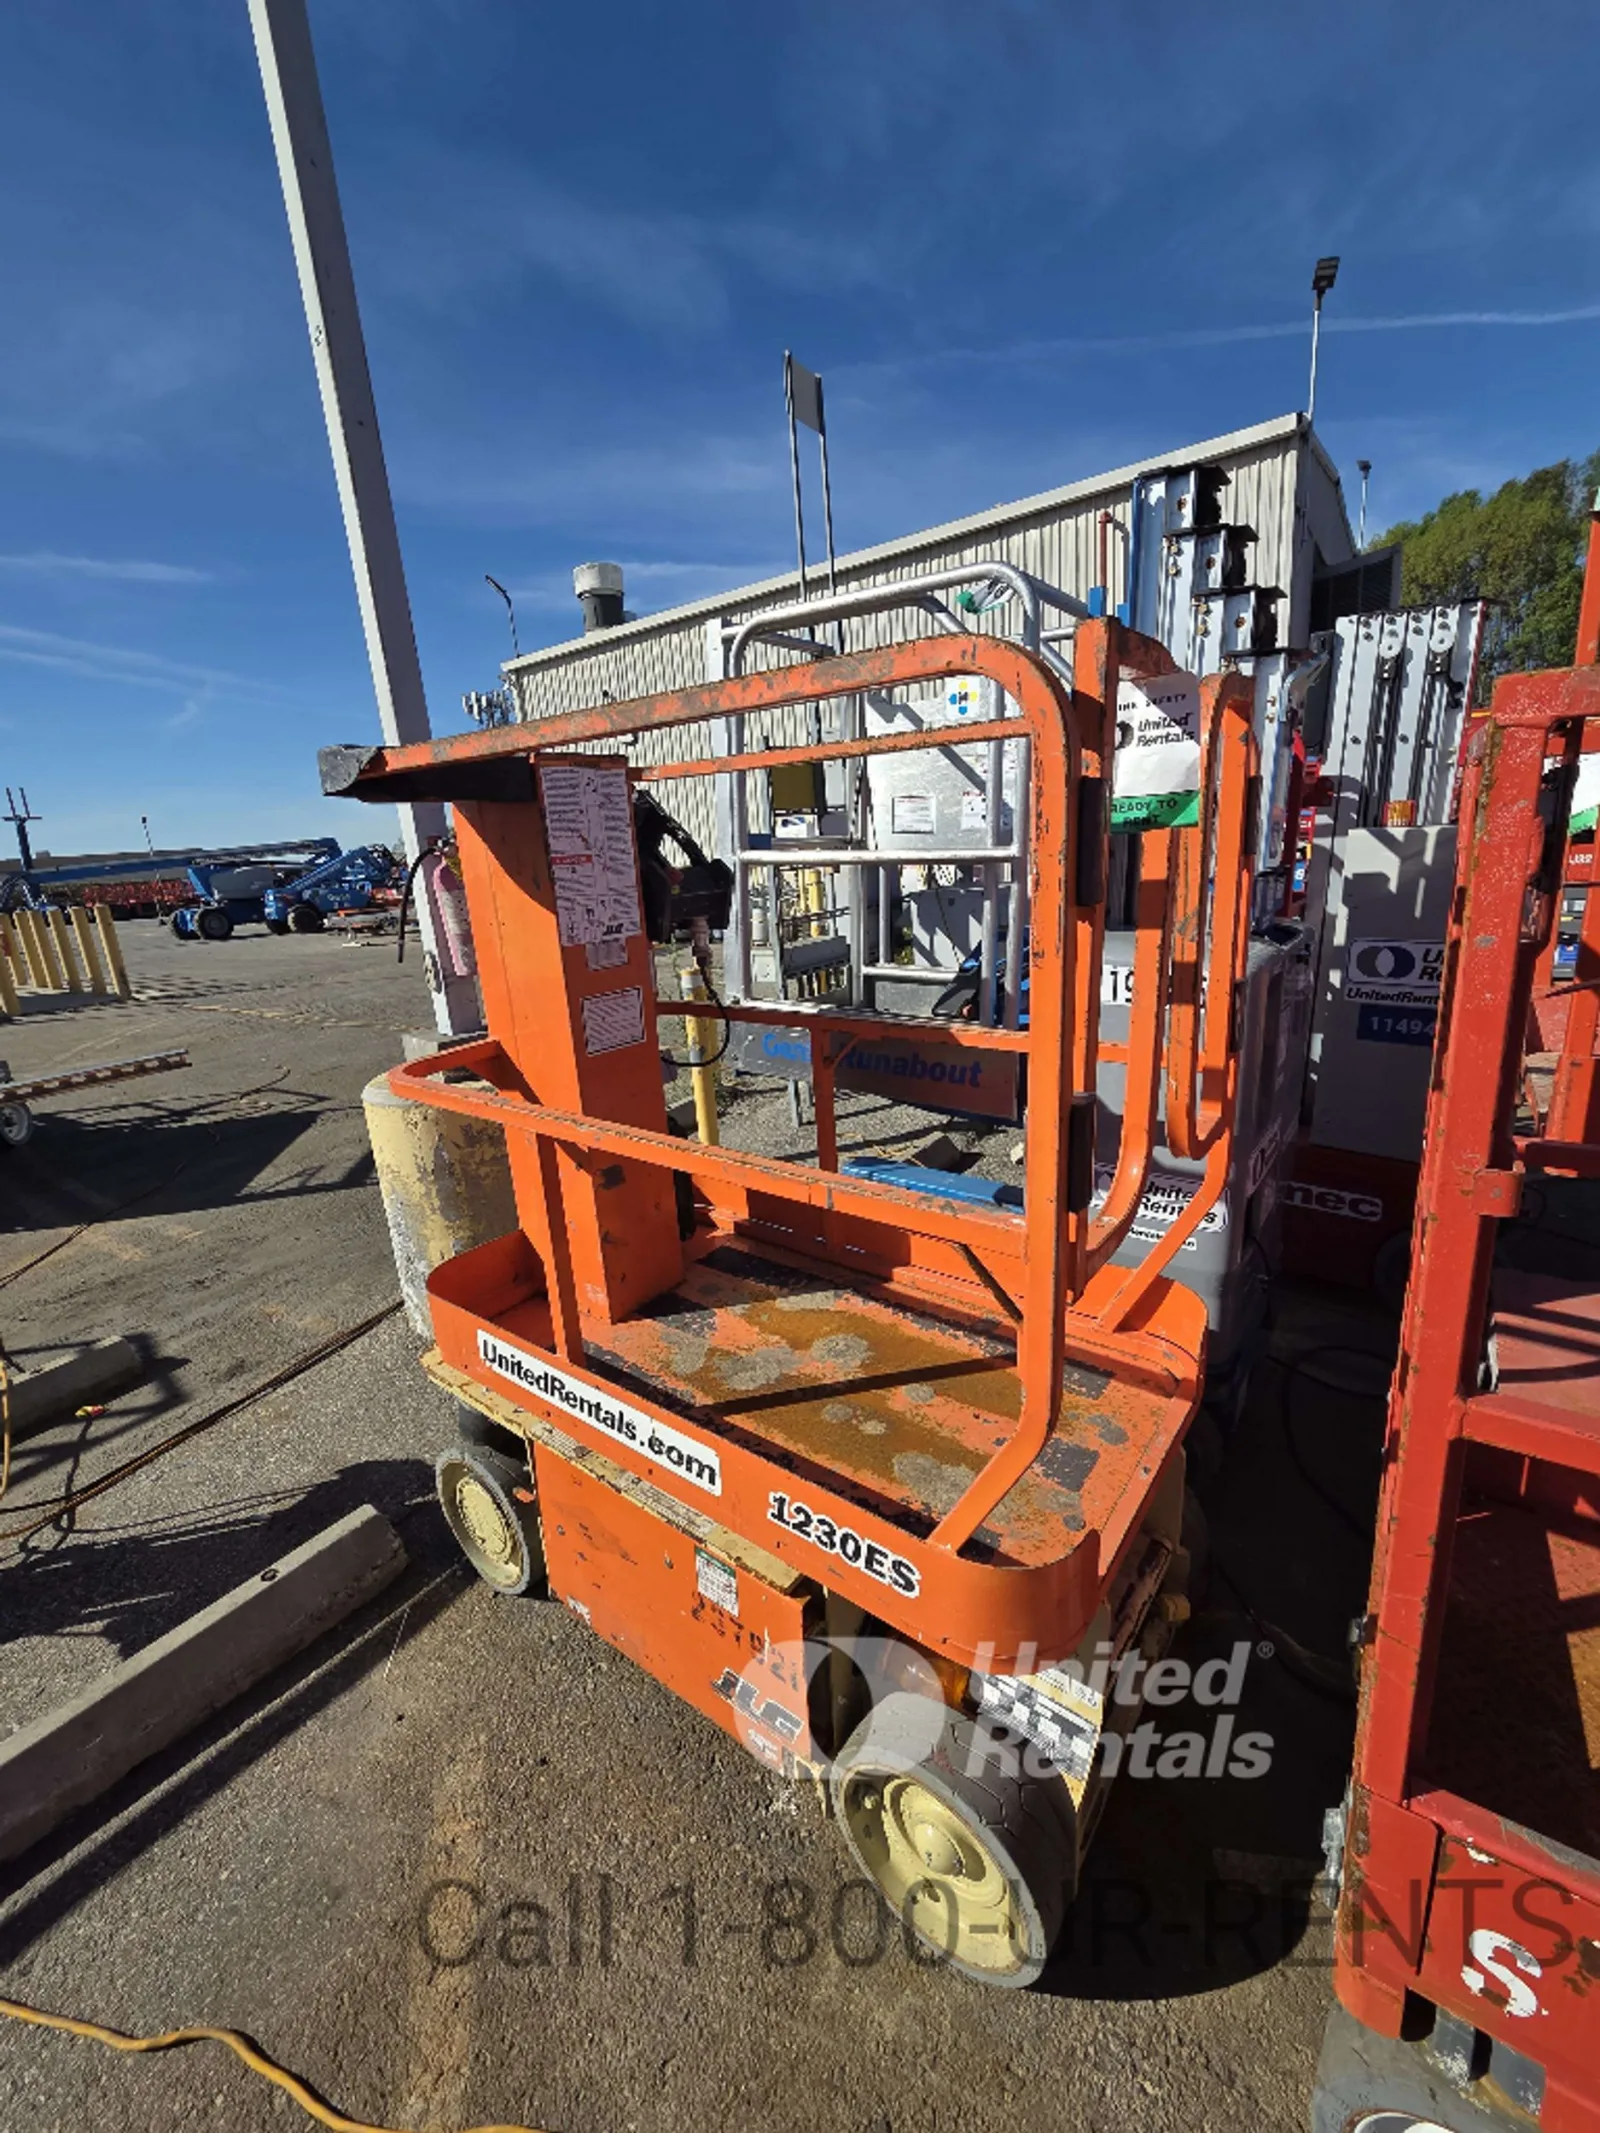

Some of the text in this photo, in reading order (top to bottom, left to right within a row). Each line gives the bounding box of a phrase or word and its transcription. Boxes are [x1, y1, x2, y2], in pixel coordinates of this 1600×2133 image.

[1138, 711, 1195, 732] United
[1136, 728, 1196, 747] Rentals
[1158, 798, 1178, 810] TO
[482, 1338, 718, 1488] UnitedRentals.com
[769, 1493, 919, 1595] 1230ES
